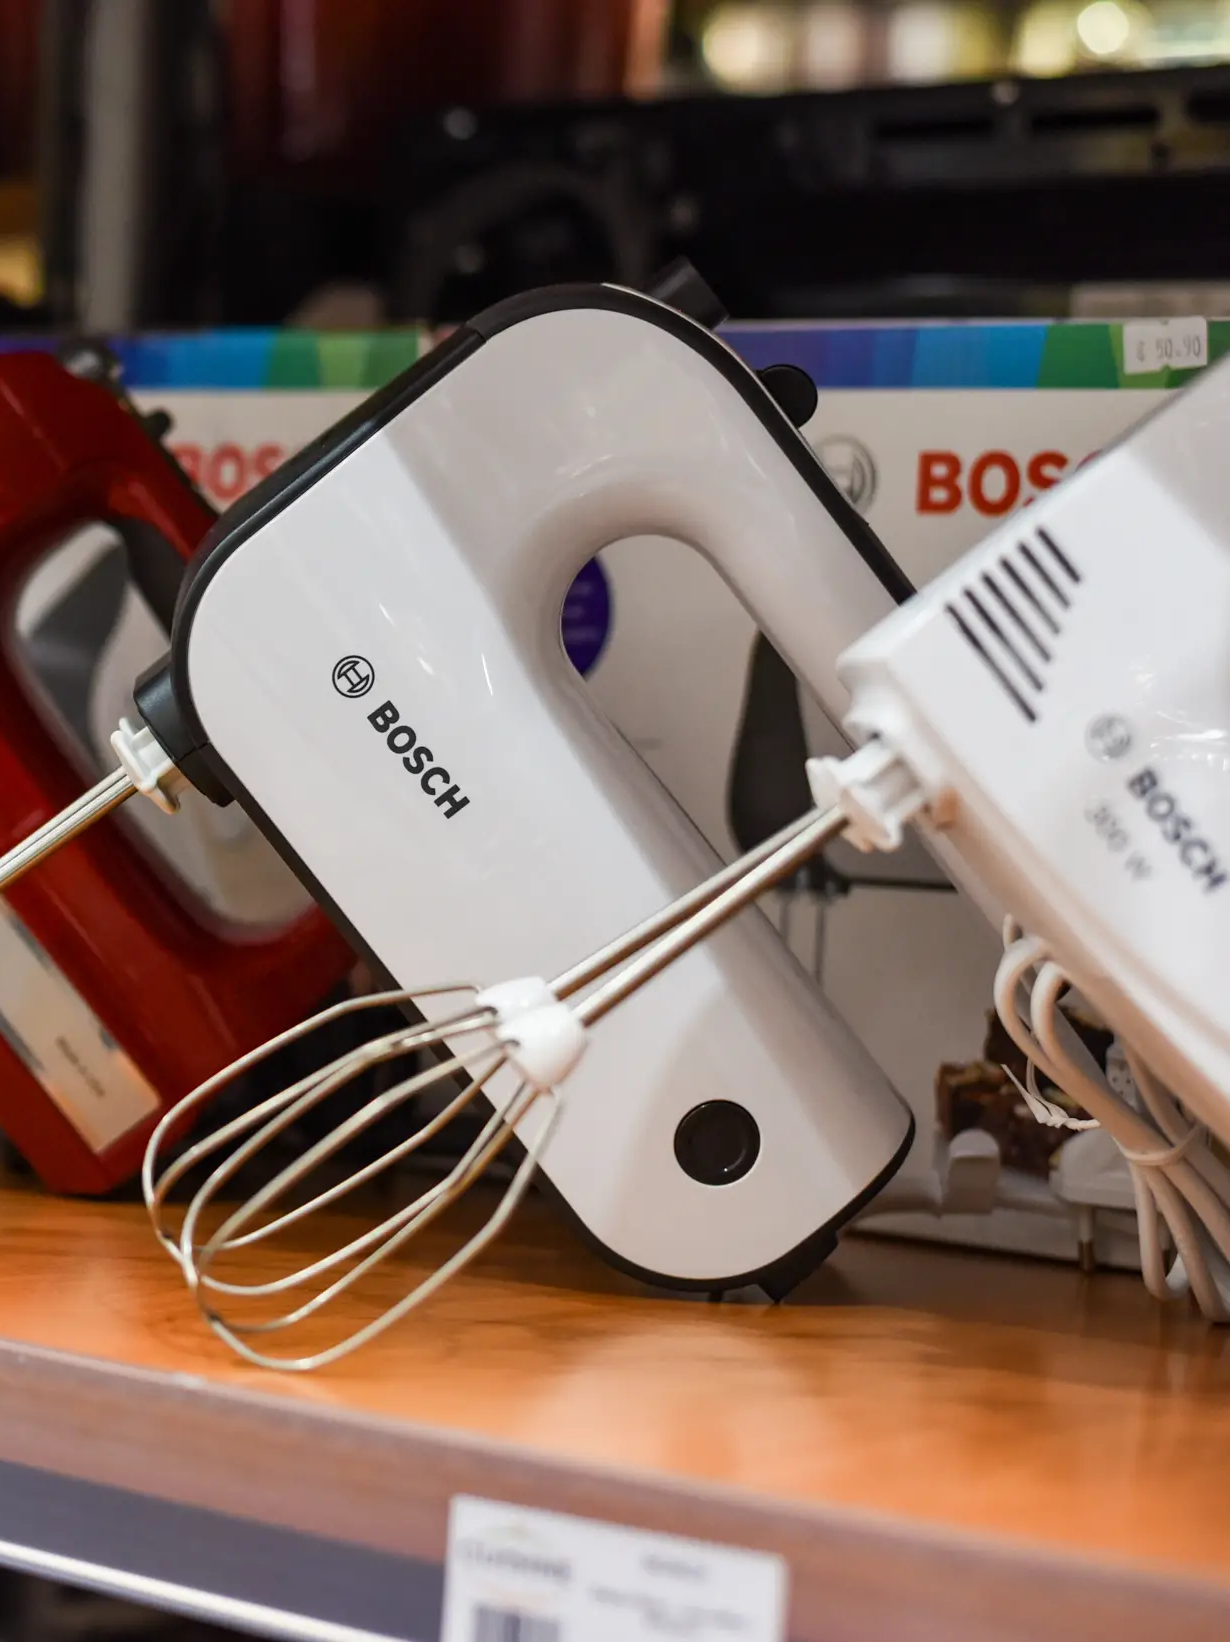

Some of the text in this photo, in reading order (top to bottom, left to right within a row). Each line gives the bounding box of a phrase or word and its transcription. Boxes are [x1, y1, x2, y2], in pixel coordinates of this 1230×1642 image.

[915, 449, 1104, 518] BOS
[367, 700, 471, 819] BOSCH
[1127, 767, 1229, 893] BOSCH
